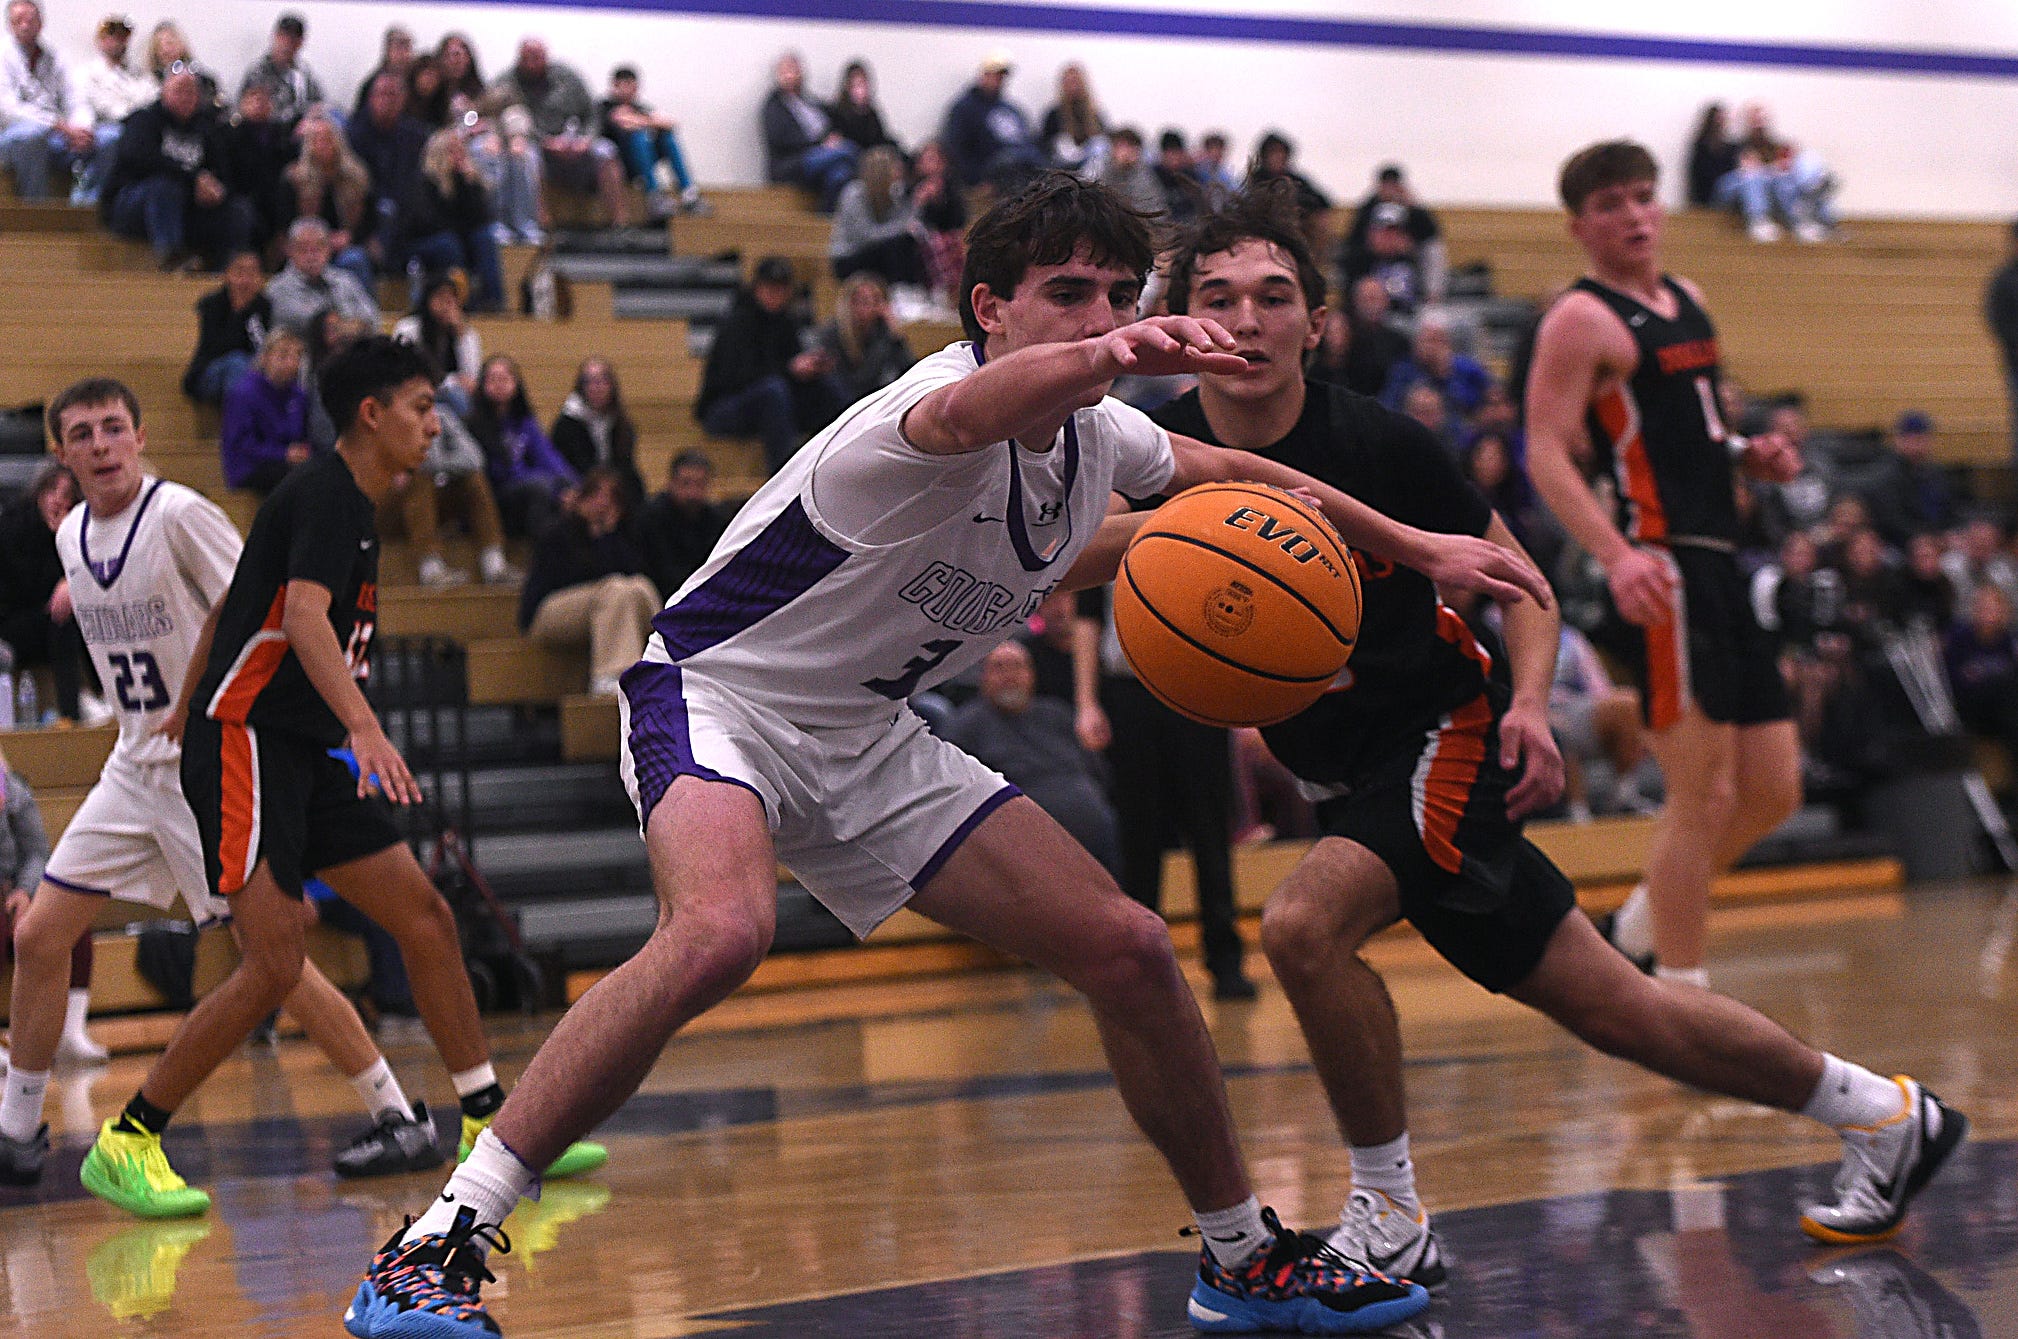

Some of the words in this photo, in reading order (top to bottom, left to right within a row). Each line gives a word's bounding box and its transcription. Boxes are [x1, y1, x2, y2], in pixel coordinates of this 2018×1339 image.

[1223, 506, 1320, 564] EVO
[1319, 554, 1341, 579] NXT
[108, 651, 171, 711] 23
